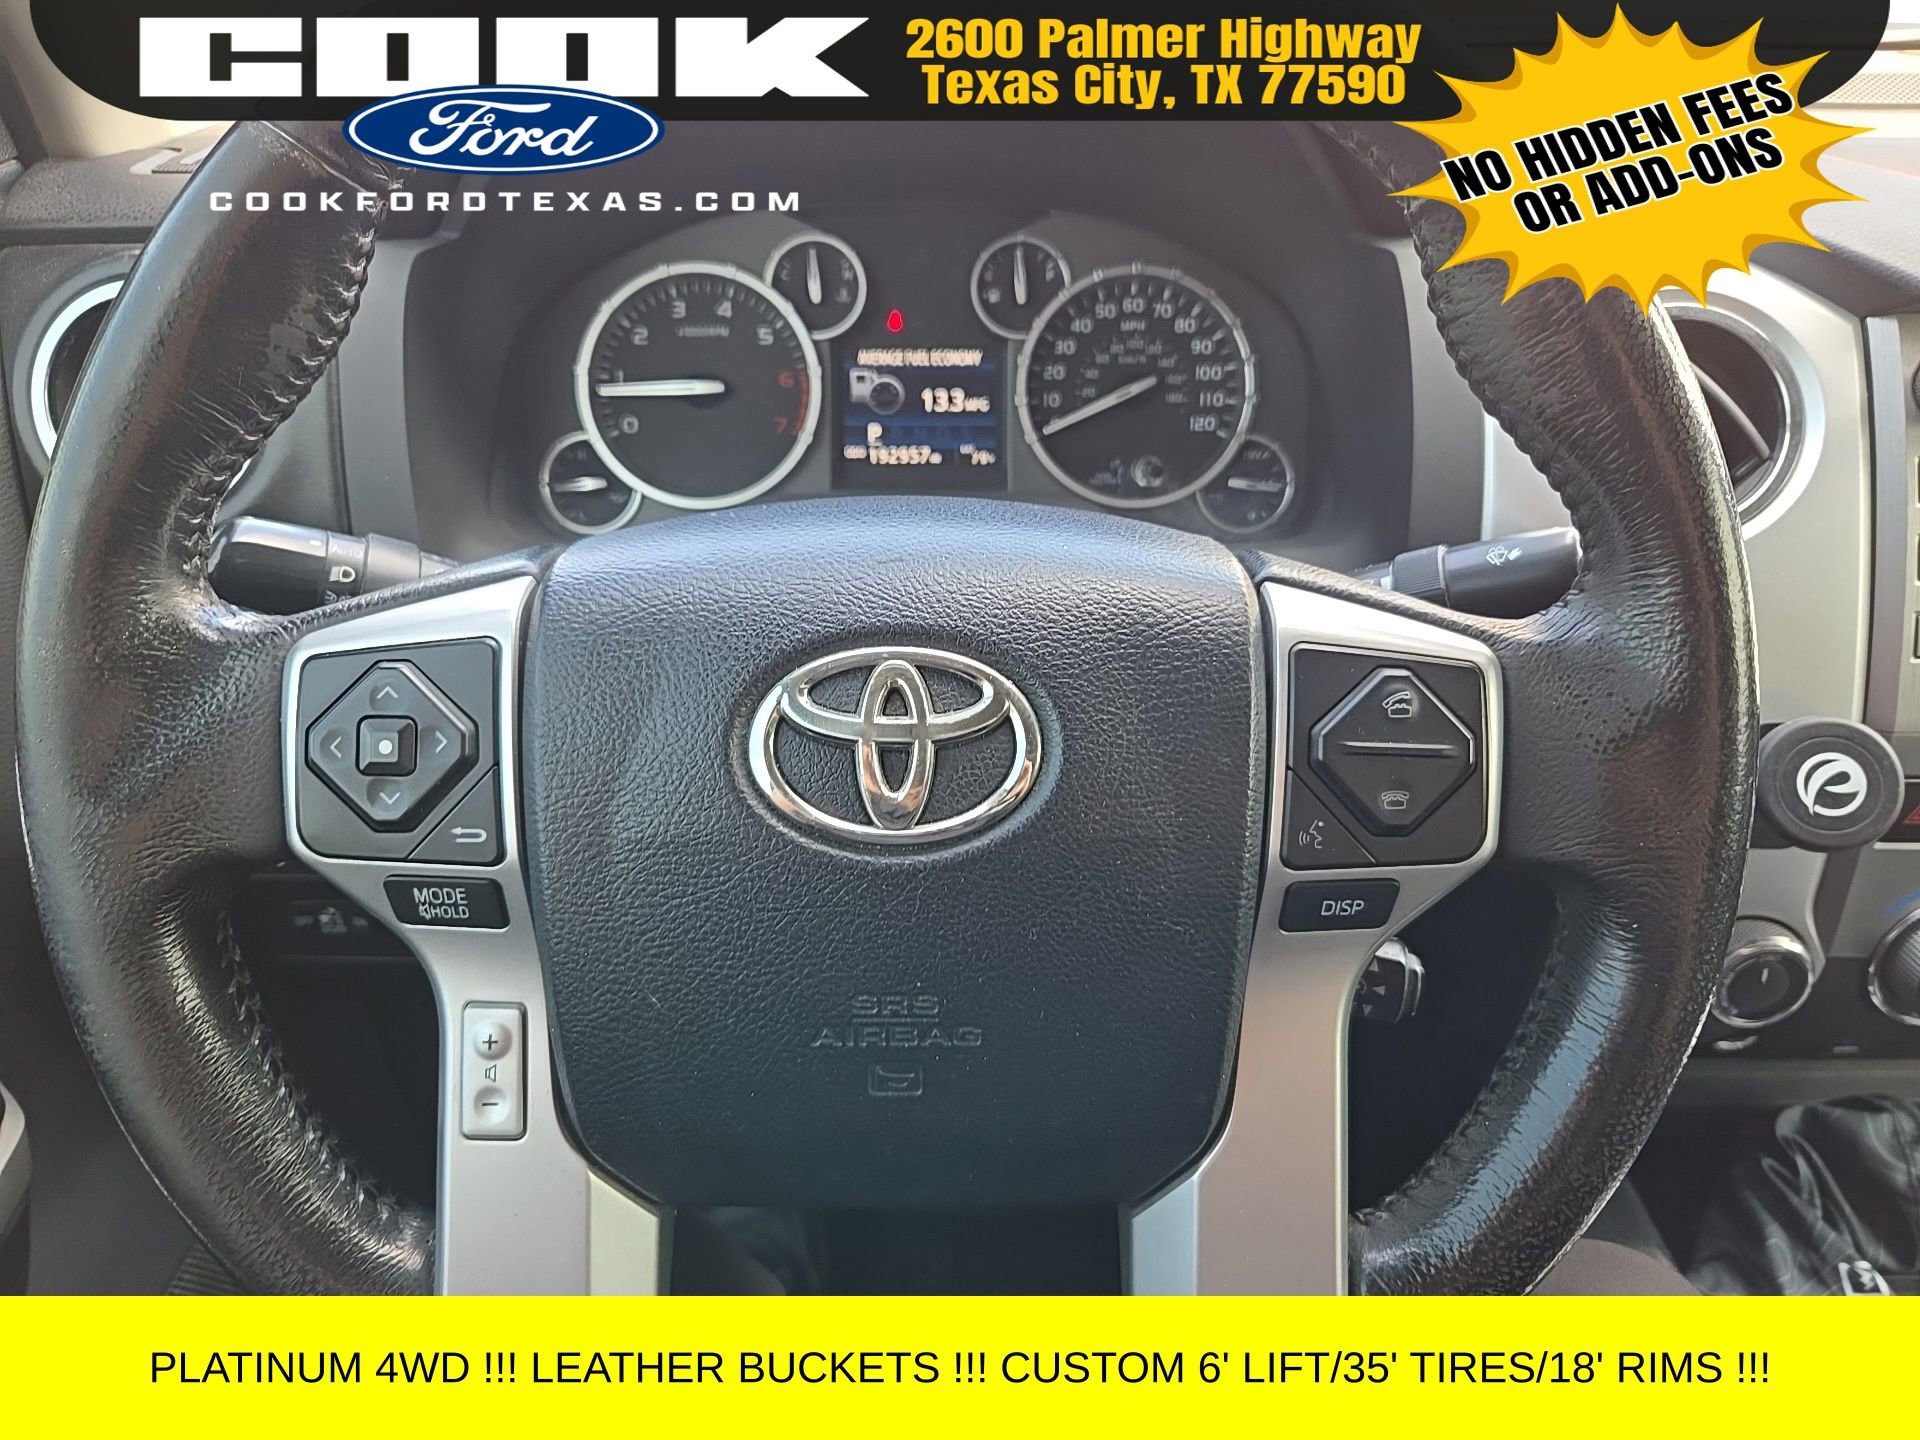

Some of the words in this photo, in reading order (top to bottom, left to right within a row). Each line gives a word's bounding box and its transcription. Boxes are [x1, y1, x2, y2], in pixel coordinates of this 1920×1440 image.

[671, 301, 687, 319] 3
[716, 300, 733, 319] 4
[1095, 303, 1117, 319] 50
[1122, 298, 1145, 314] 60
[1153, 303, 1174, 319] 70
[1071, 319, 1094, 334] 40
[1120, 319, 1146, 331] MPH
[1174, 318, 1198, 334] 80
[631, 327, 649, 346] 2
[756, 327, 774, 346] 5
[1054, 340, 1077, 355] 30
[1190, 338, 1214, 355] 90
[1043, 365, 1067, 381] 20
[1195, 365, 1224, 381] 100
[1043, 393, 1061, 409] 10
[1199, 392, 1225, 408] 110
[620, 414, 639, 434] 0
[1190, 416, 1217, 432] 120
[413, 887, 468, 904] MODE
[430, 904, 470, 919] HOLD
[1320, 900, 1364, 916] DISP
[852, 995, 939, 1015] SRS
[810, 1027, 982, 1047] AIRBAG
